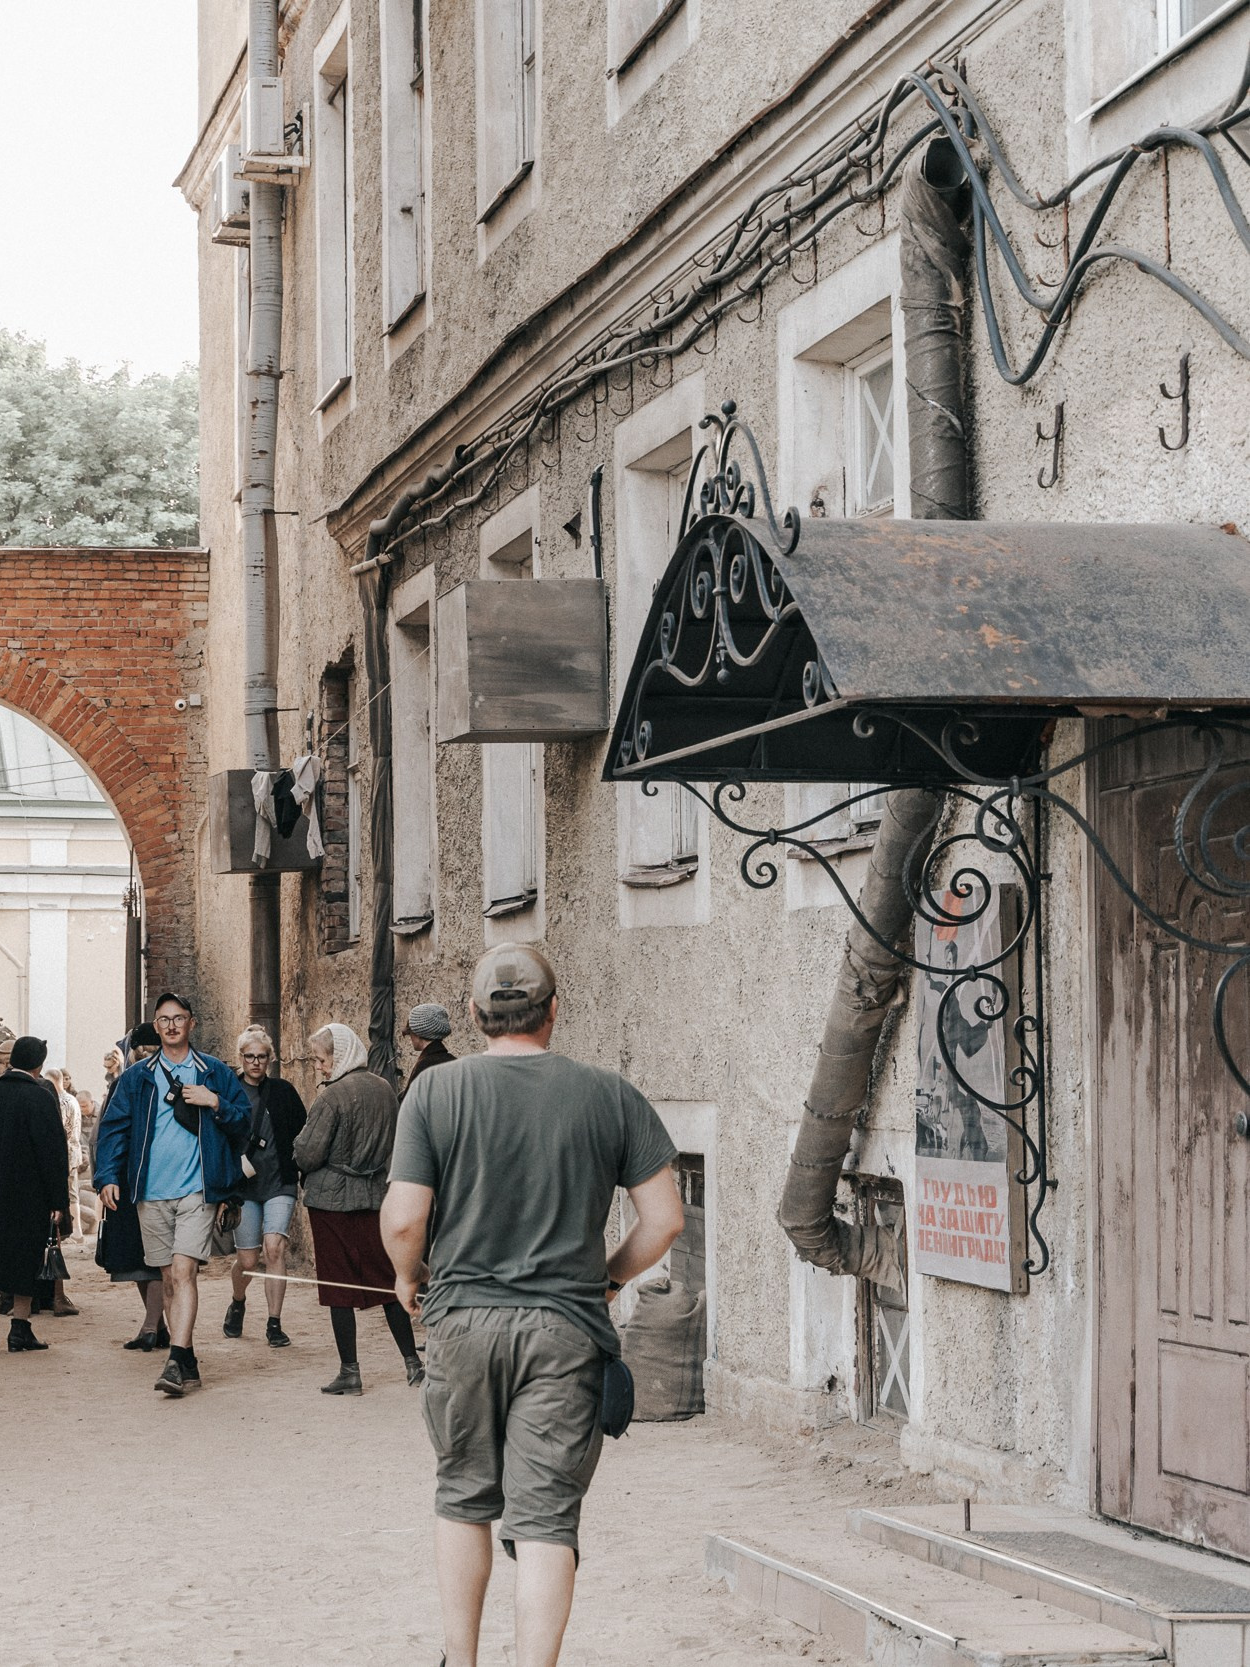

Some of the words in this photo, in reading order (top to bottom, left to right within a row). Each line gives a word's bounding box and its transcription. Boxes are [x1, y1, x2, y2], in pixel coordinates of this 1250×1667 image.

[922, 1178, 997, 1209] ГРУДЬЮ
[917, 1203, 937, 1227] НА
[938, 1207, 1005, 1237] ЗАЩИТУ
